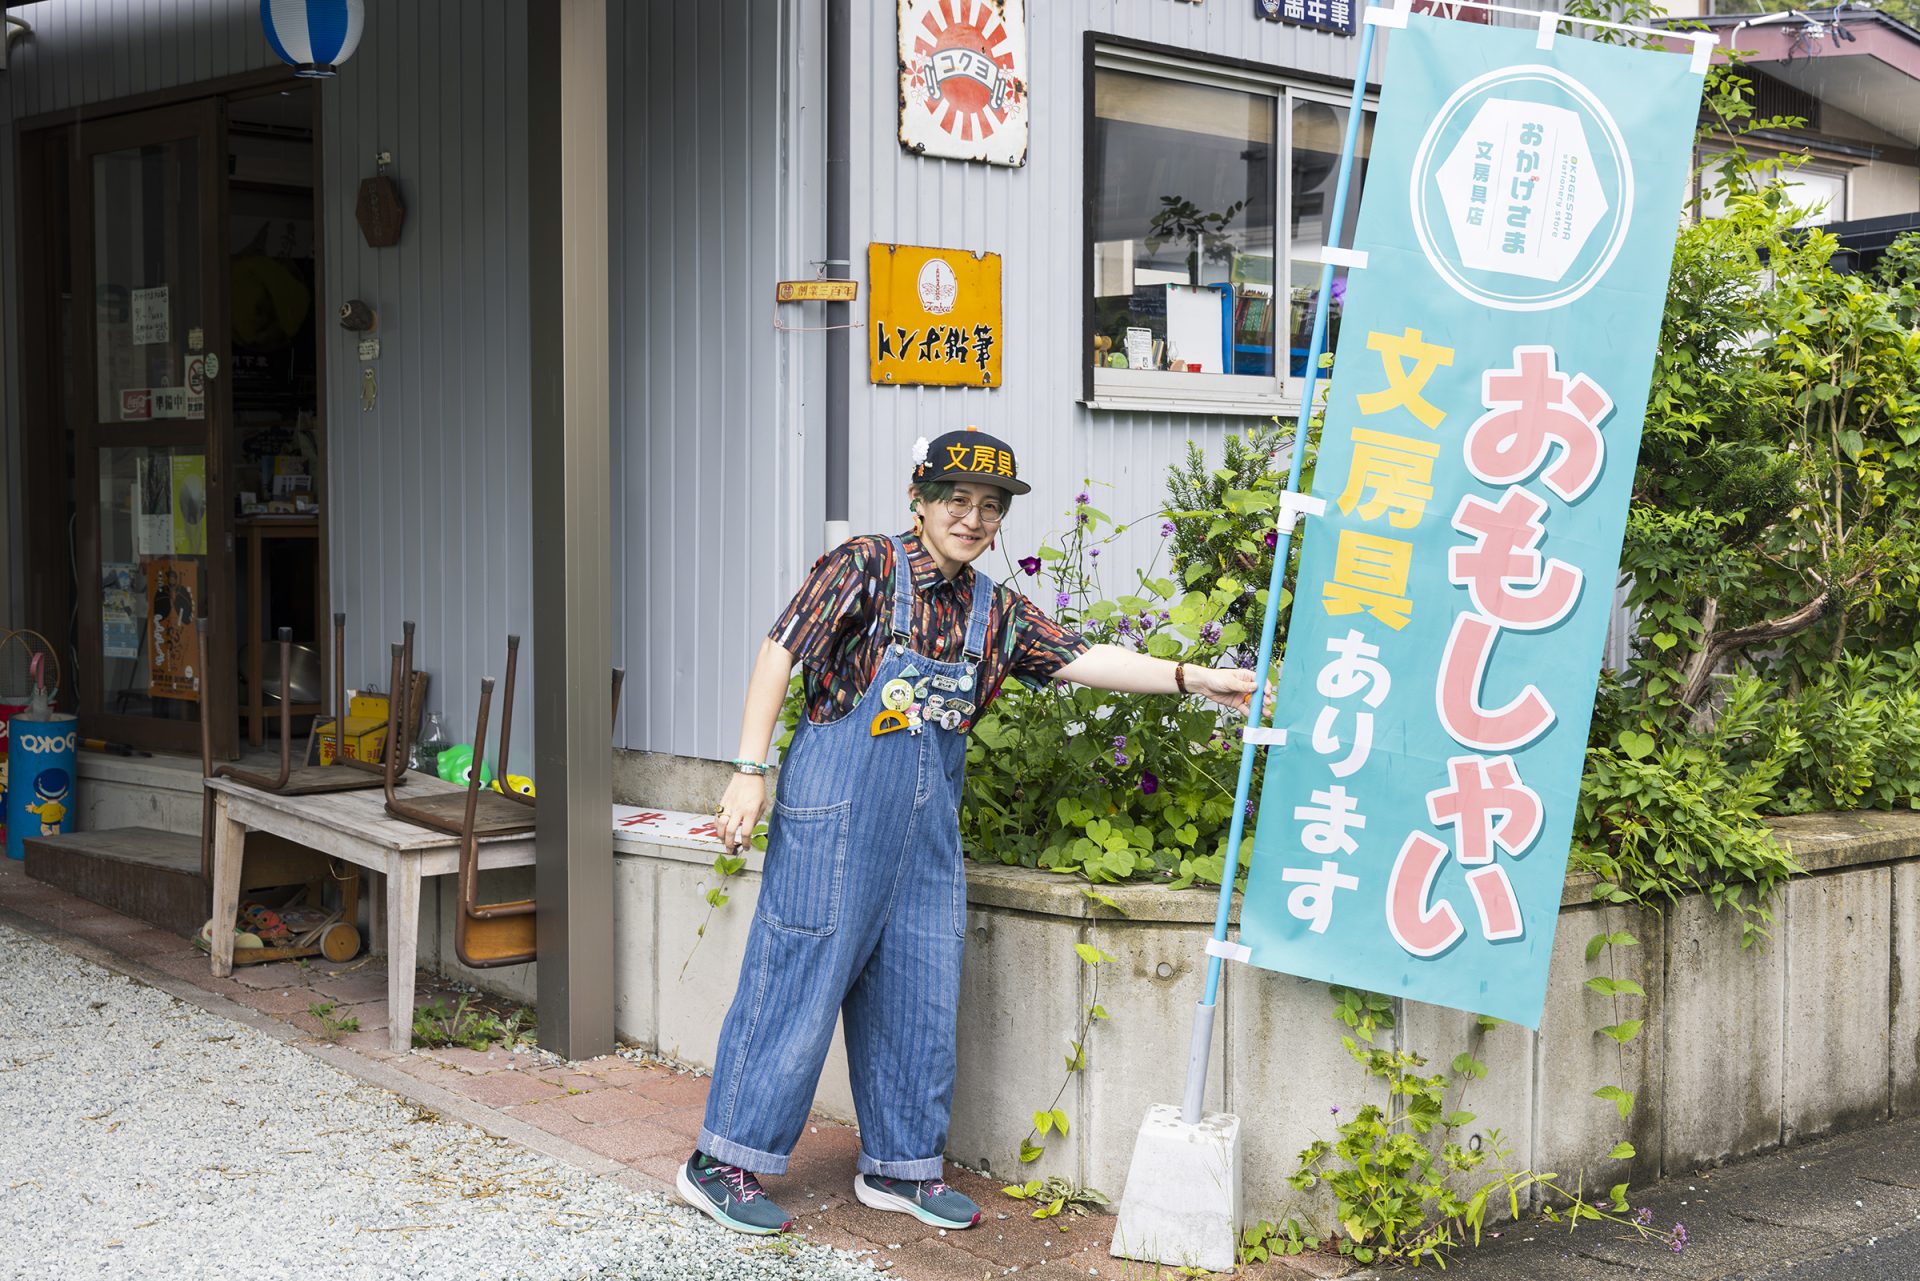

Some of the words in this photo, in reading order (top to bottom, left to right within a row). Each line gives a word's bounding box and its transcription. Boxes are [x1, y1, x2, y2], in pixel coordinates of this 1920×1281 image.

[940, 52, 990, 80] コクヨ
[1465, 140, 1494, 226] 文房具店
[1502, 122, 1545, 254] おかげさま
[1557, 153, 1569, 210] stationery
[1561, 155, 1578, 241] OKAGESAMA
[1551, 210, 1562, 238] store
[878, 321, 994, 371] トンボ鉛筆
[156, 394, 182, 411] 準備中
[943, 442, 1014, 478] 文房具
